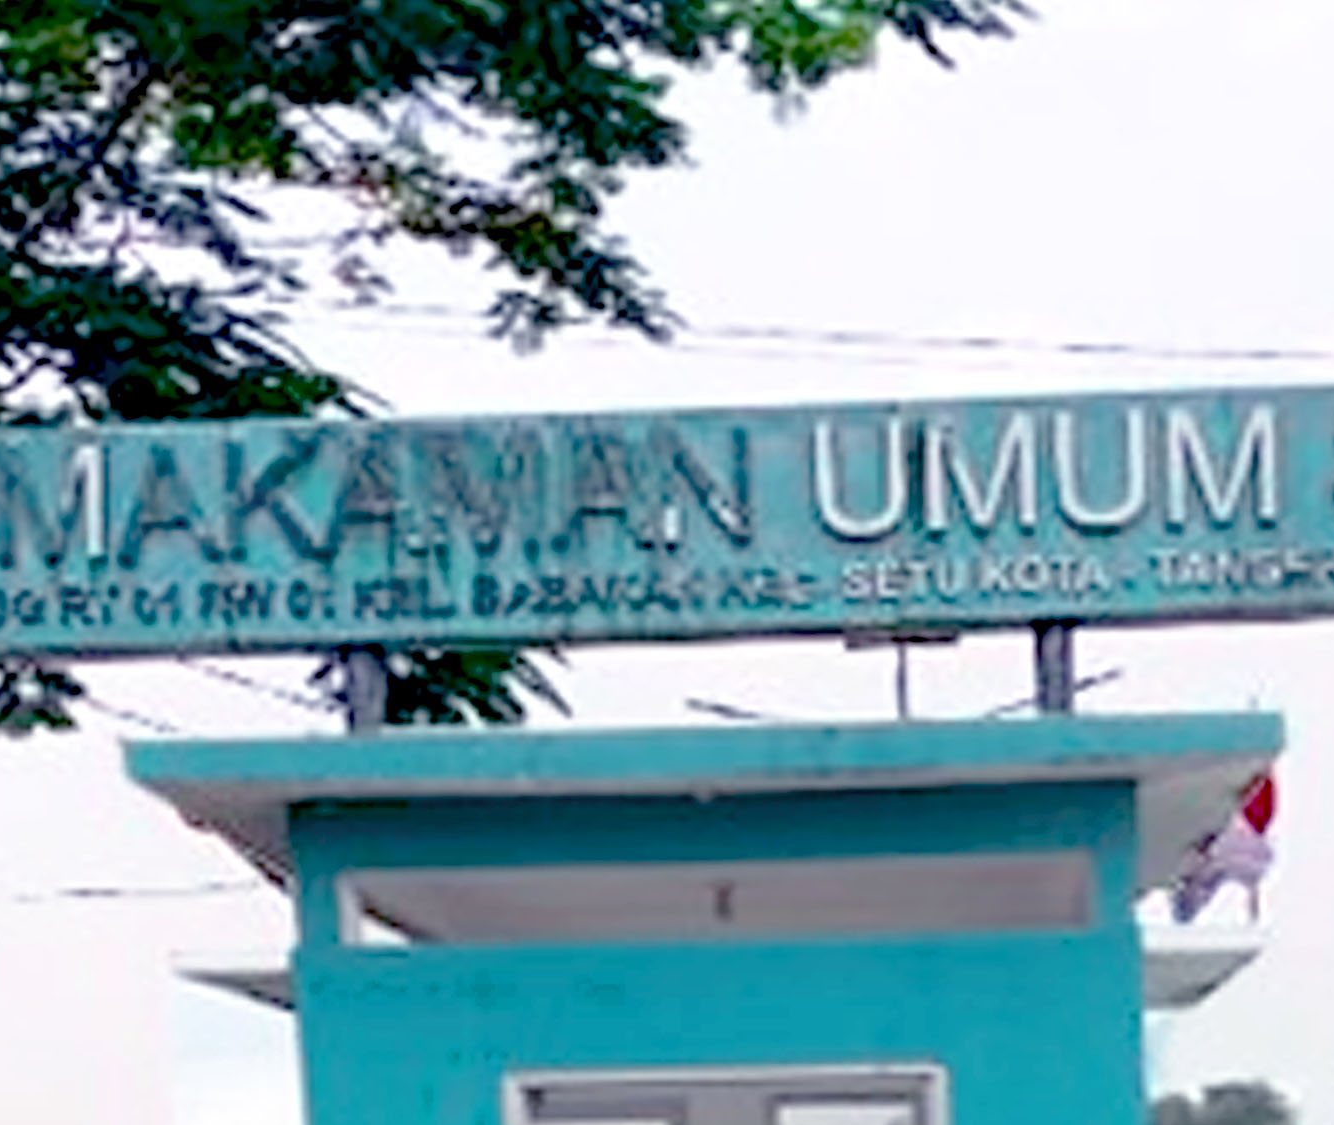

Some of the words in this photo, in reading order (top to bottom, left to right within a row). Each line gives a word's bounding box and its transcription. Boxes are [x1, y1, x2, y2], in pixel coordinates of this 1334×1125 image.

[812, 404, 1279, 540] UMUM
[842, 552, 961, 604] SETU
[975, 549, 1113, 602] KOTA
